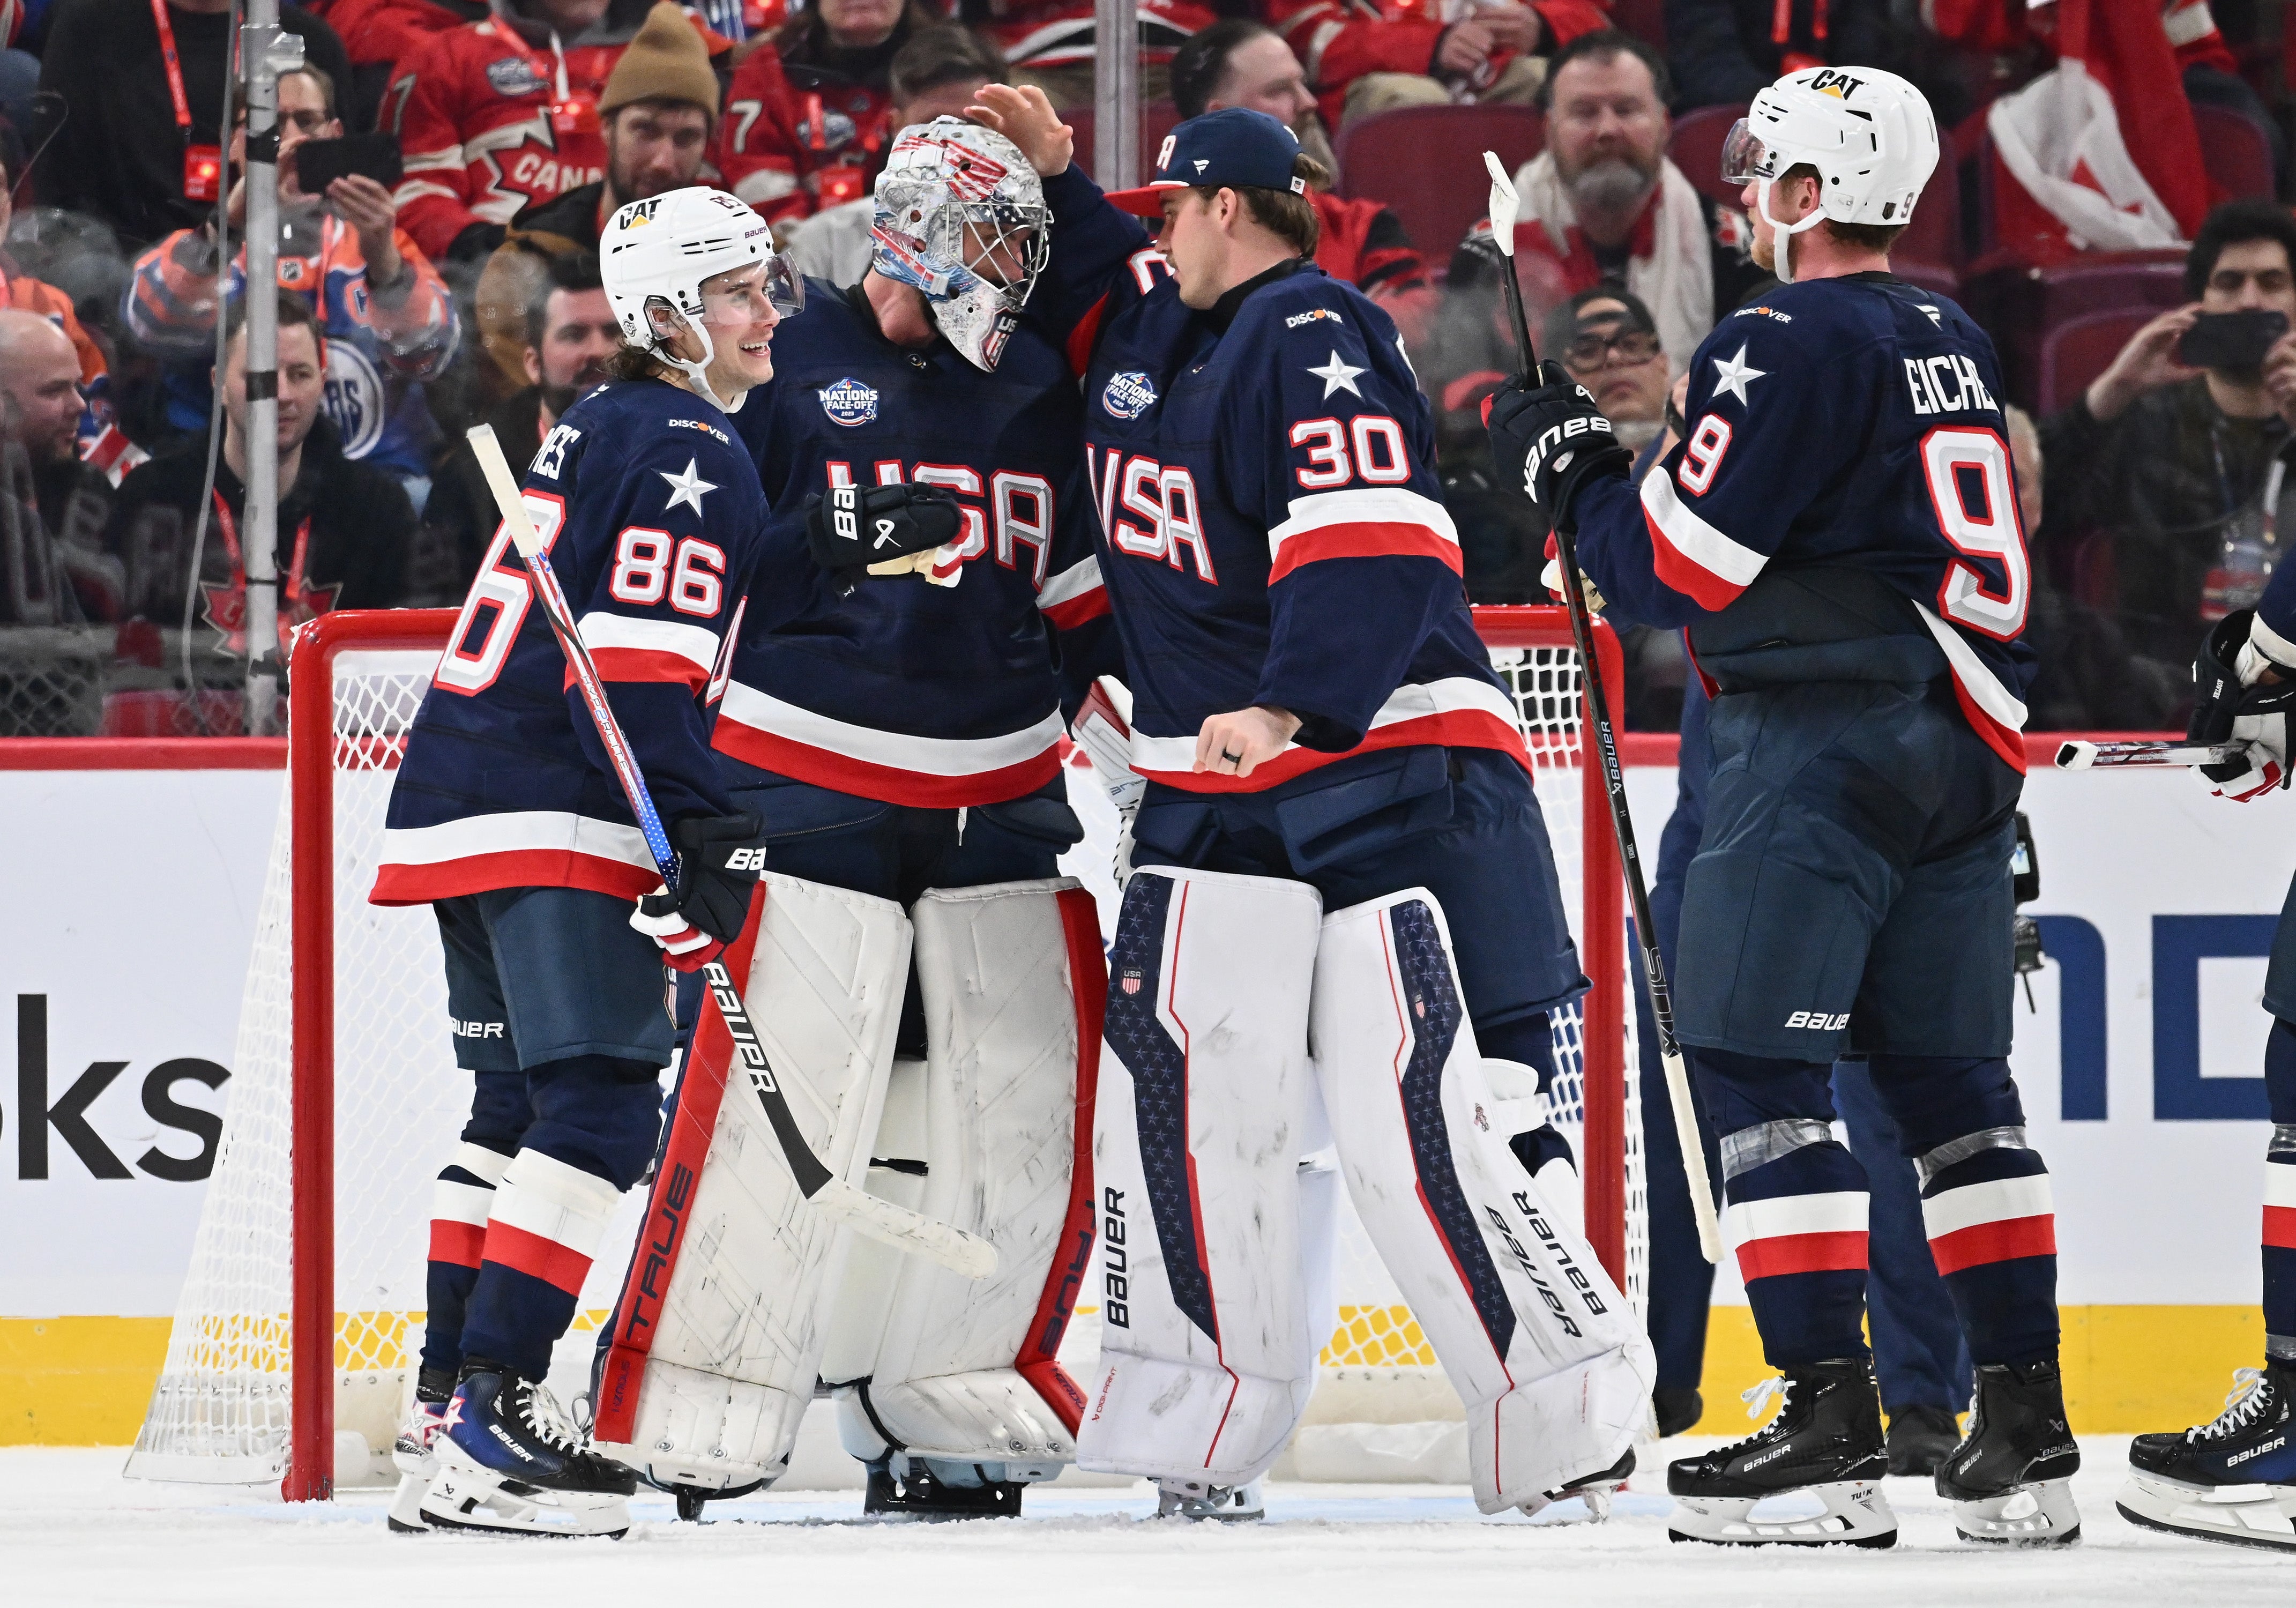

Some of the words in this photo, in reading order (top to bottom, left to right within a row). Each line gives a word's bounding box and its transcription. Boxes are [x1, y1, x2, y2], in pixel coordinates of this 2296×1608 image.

[1811, 70, 1865, 100] CAT
[730, 100, 762, 154] 7
[620, 199, 663, 230] CAT
[1285, 309, 1343, 328] DISCOVER
[1734, 307, 1792, 324] DISCOVER
[818, 390, 878, 401] NATIONS
[826, 401, 874, 410] FACE-OFF
[1107, 384, 1146, 408] FACE-OFF
[1110, 373, 1158, 404] NATIONS
[1904, 354, 2000, 415] EICHE
[668, 419, 729, 444] DISCOVER
[1289, 415, 1411, 490] 30
[1678, 413, 1732, 497] 9
[1086, 443, 1218, 586] USA
[1919, 423, 2031, 643] 9
[609, 526, 726, 618] 86
[582, 675, 629, 770] HYP2RLITE
[1785, 1011, 1851, 1030] BAUE
[0, 993, 233, 1182] ks
[625, 1162, 693, 1341] TRUE
[1097, 1367, 1116, 1412] DIGI-PRINT
